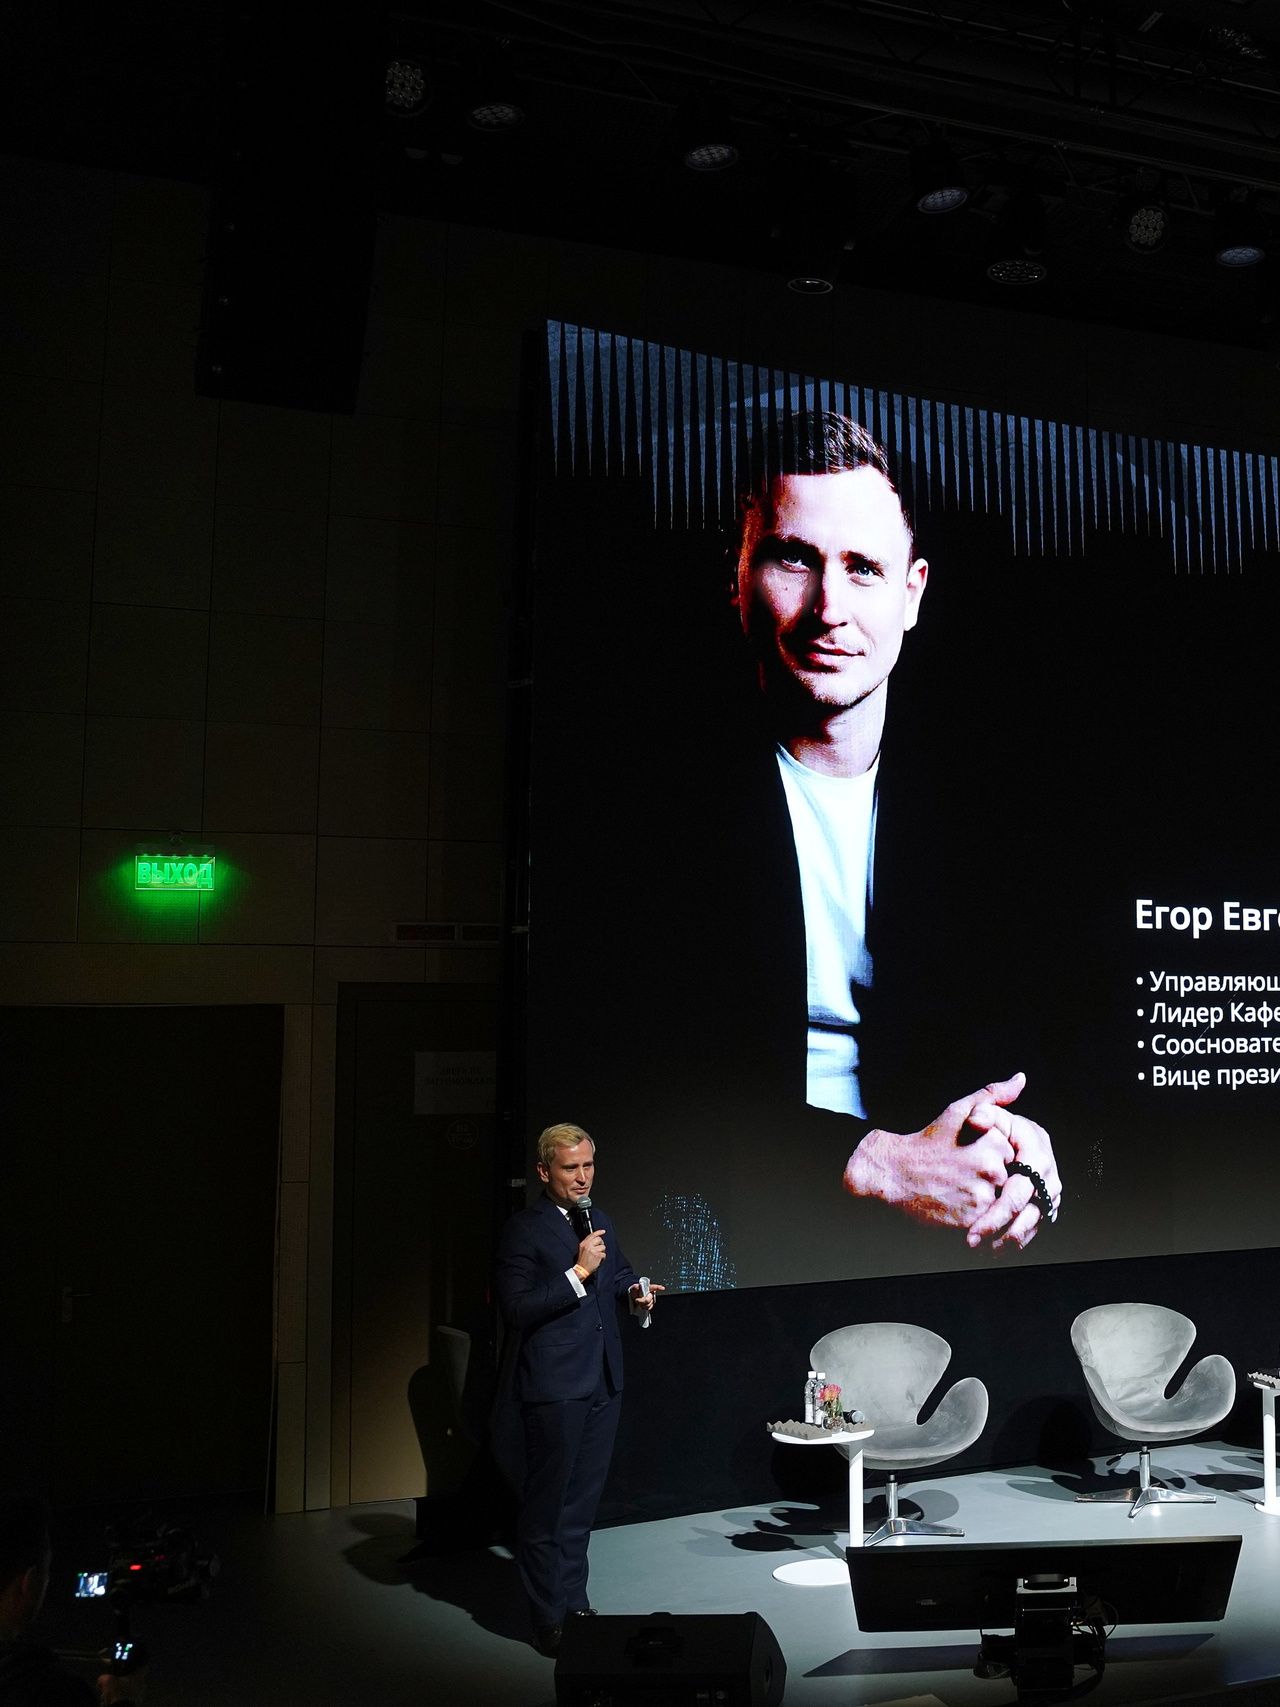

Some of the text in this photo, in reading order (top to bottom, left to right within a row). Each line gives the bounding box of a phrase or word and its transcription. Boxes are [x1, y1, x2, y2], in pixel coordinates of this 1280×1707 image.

[137, 862, 213, 889] ВЫХОД
[1136, 898, 1213, 939] Егор
[1149, 1002, 1224, 1029] Лидер
[1152, 1065, 1211, 1091] Вице
